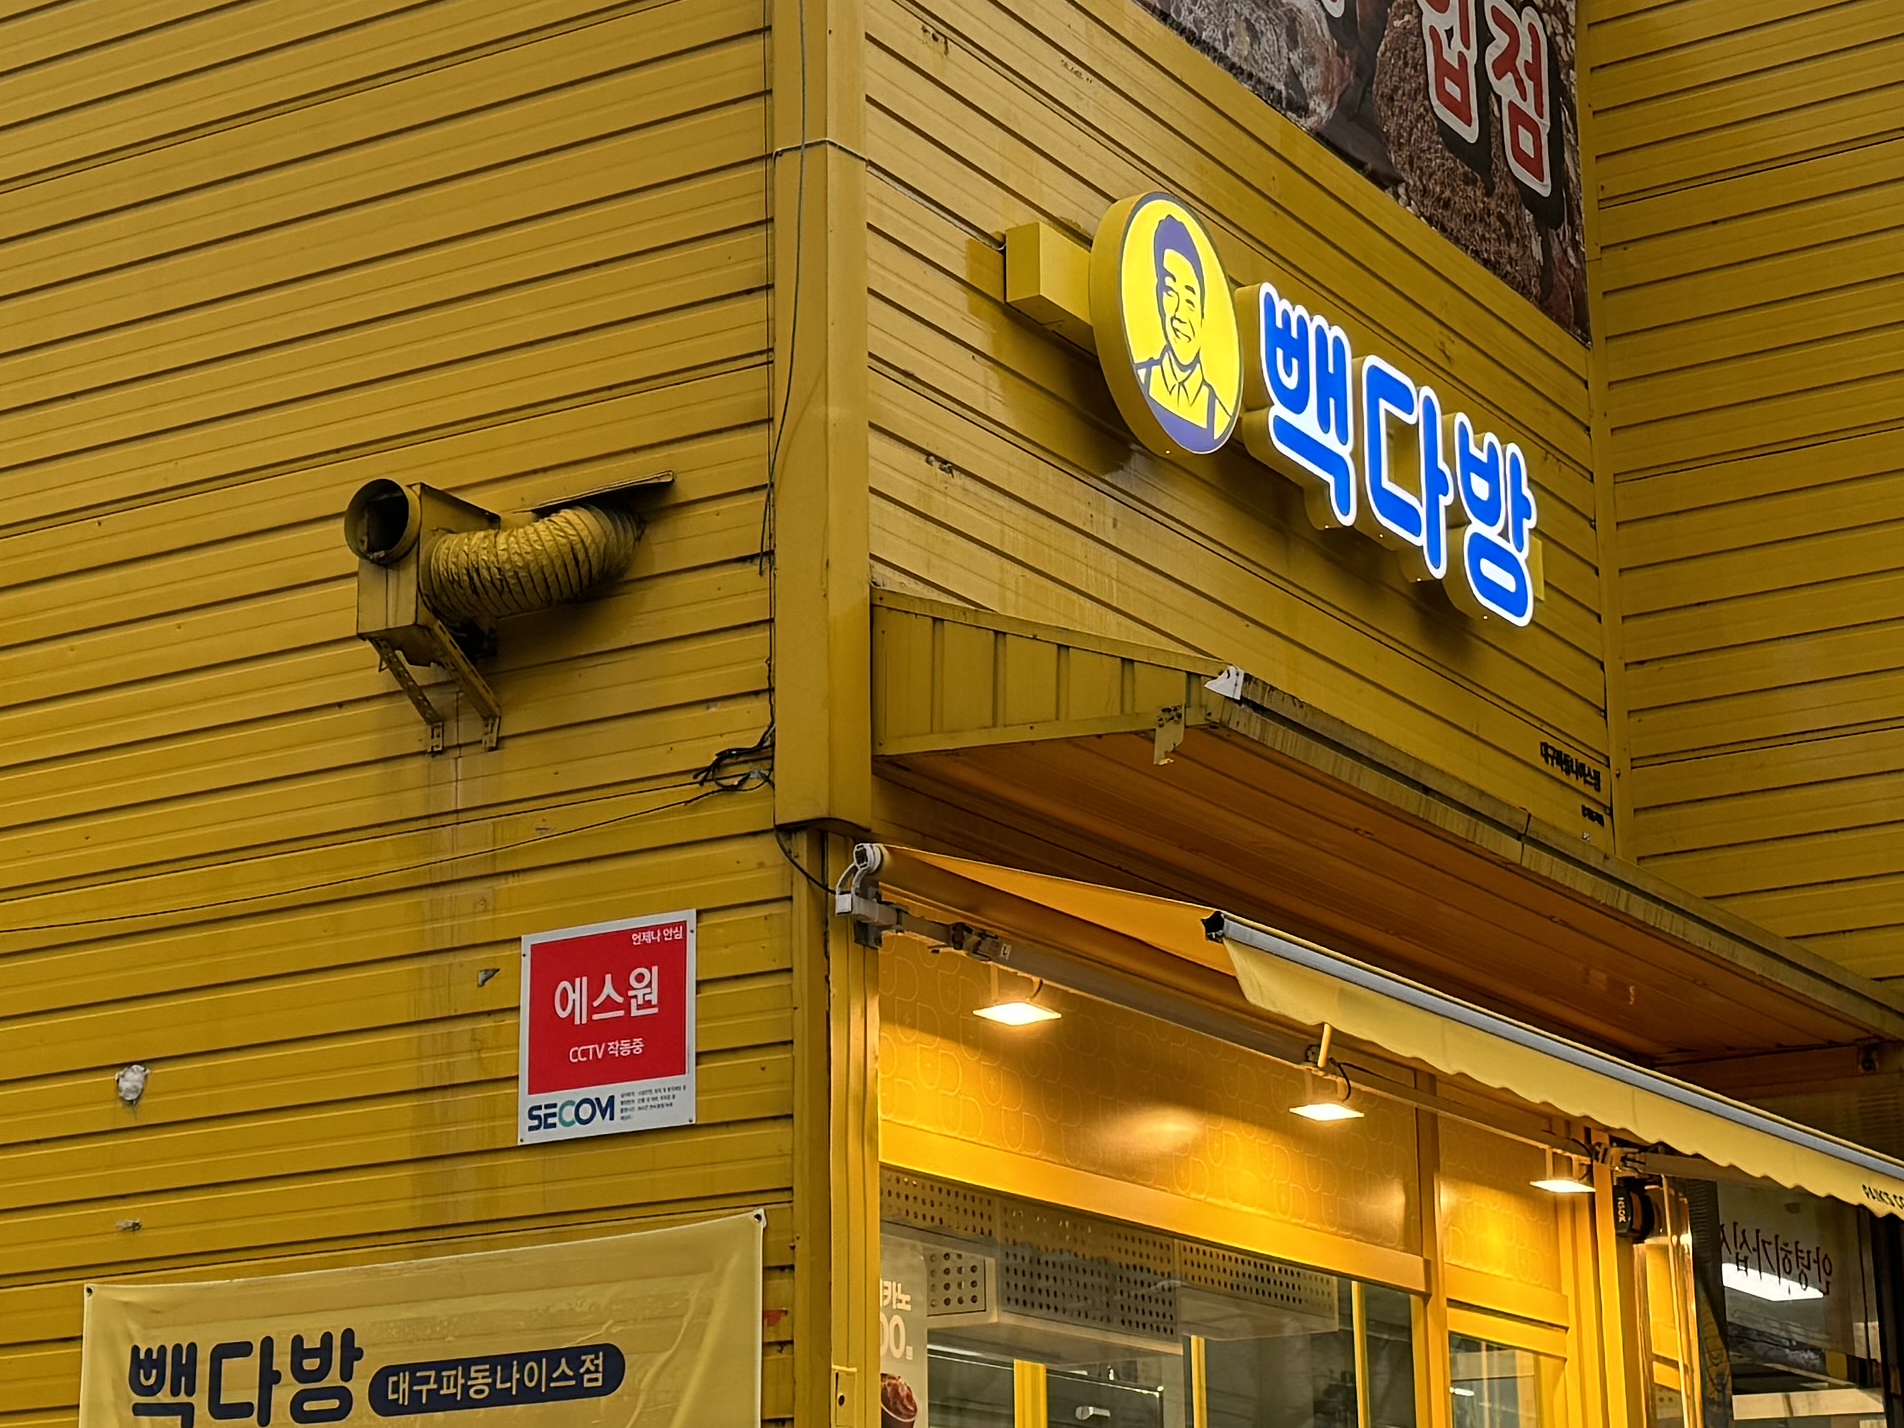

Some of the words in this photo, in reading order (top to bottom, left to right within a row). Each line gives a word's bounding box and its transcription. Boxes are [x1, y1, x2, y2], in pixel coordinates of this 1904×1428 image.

[1259, 282, 1538, 628] 빽다방
[631, 930, 661, 946] 언제나
[663, 925, 684, 942] 안심
[554, 965, 659, 1025] 에스원
[569, 1042, 605, 1063] CCTV
[607, 1038, 644, 1058] 작동중
[527, 1095, 615, 1132] SECOM
[880, 1278, 912, 1311] 카노
[385, 1349, 606, 1407] 대구파동나이스점
